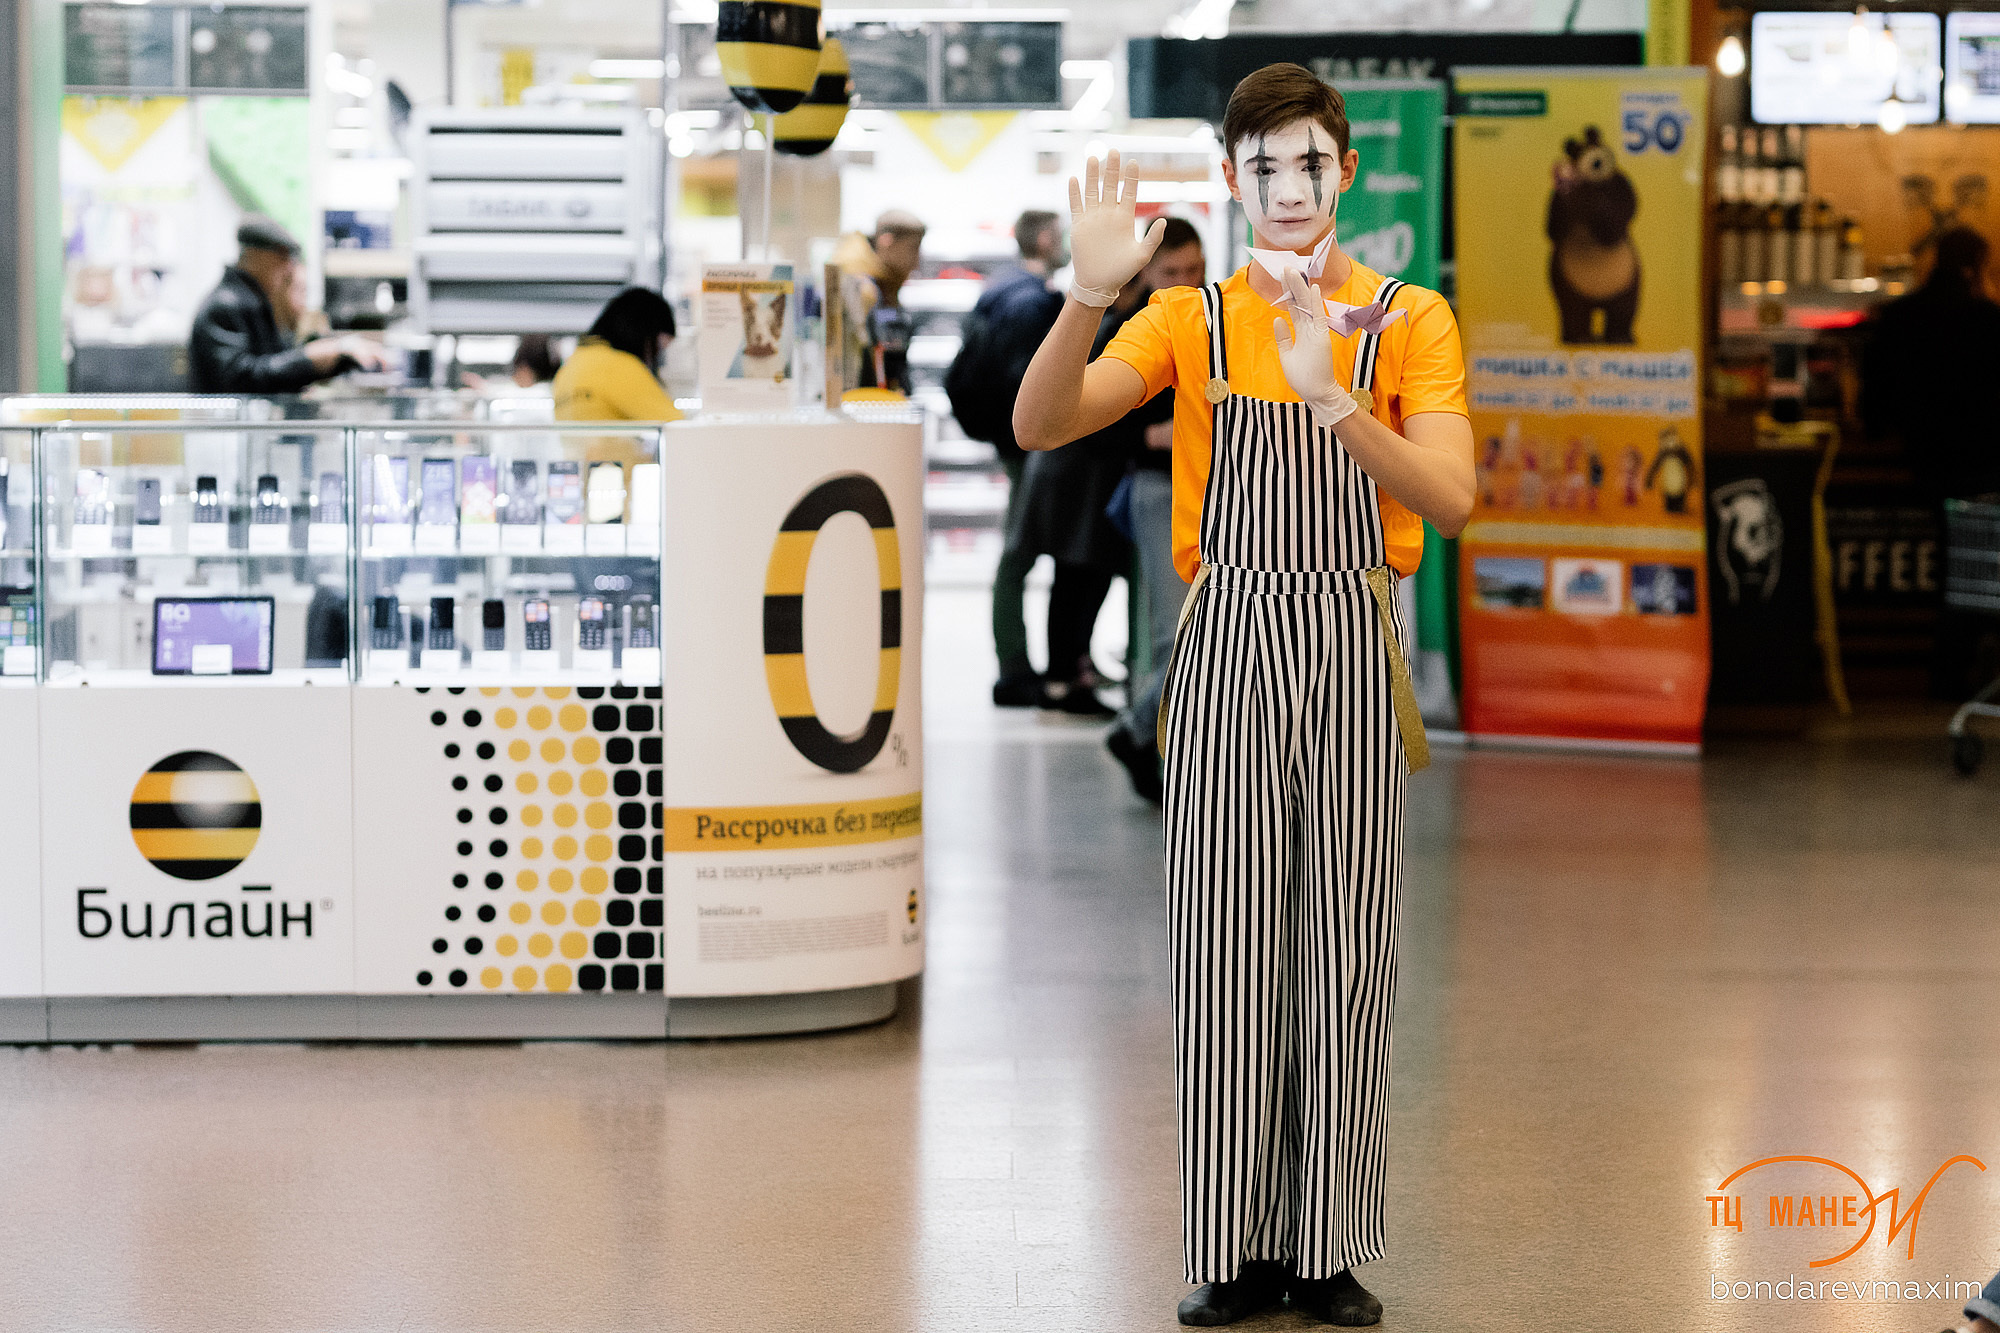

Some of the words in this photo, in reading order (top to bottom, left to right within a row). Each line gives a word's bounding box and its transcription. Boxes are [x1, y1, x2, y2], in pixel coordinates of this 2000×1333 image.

[695, 815, 828, 844] Рассрочка
[834, 808, 867, 833] без
[77, 885, 313, 939] Билайн
